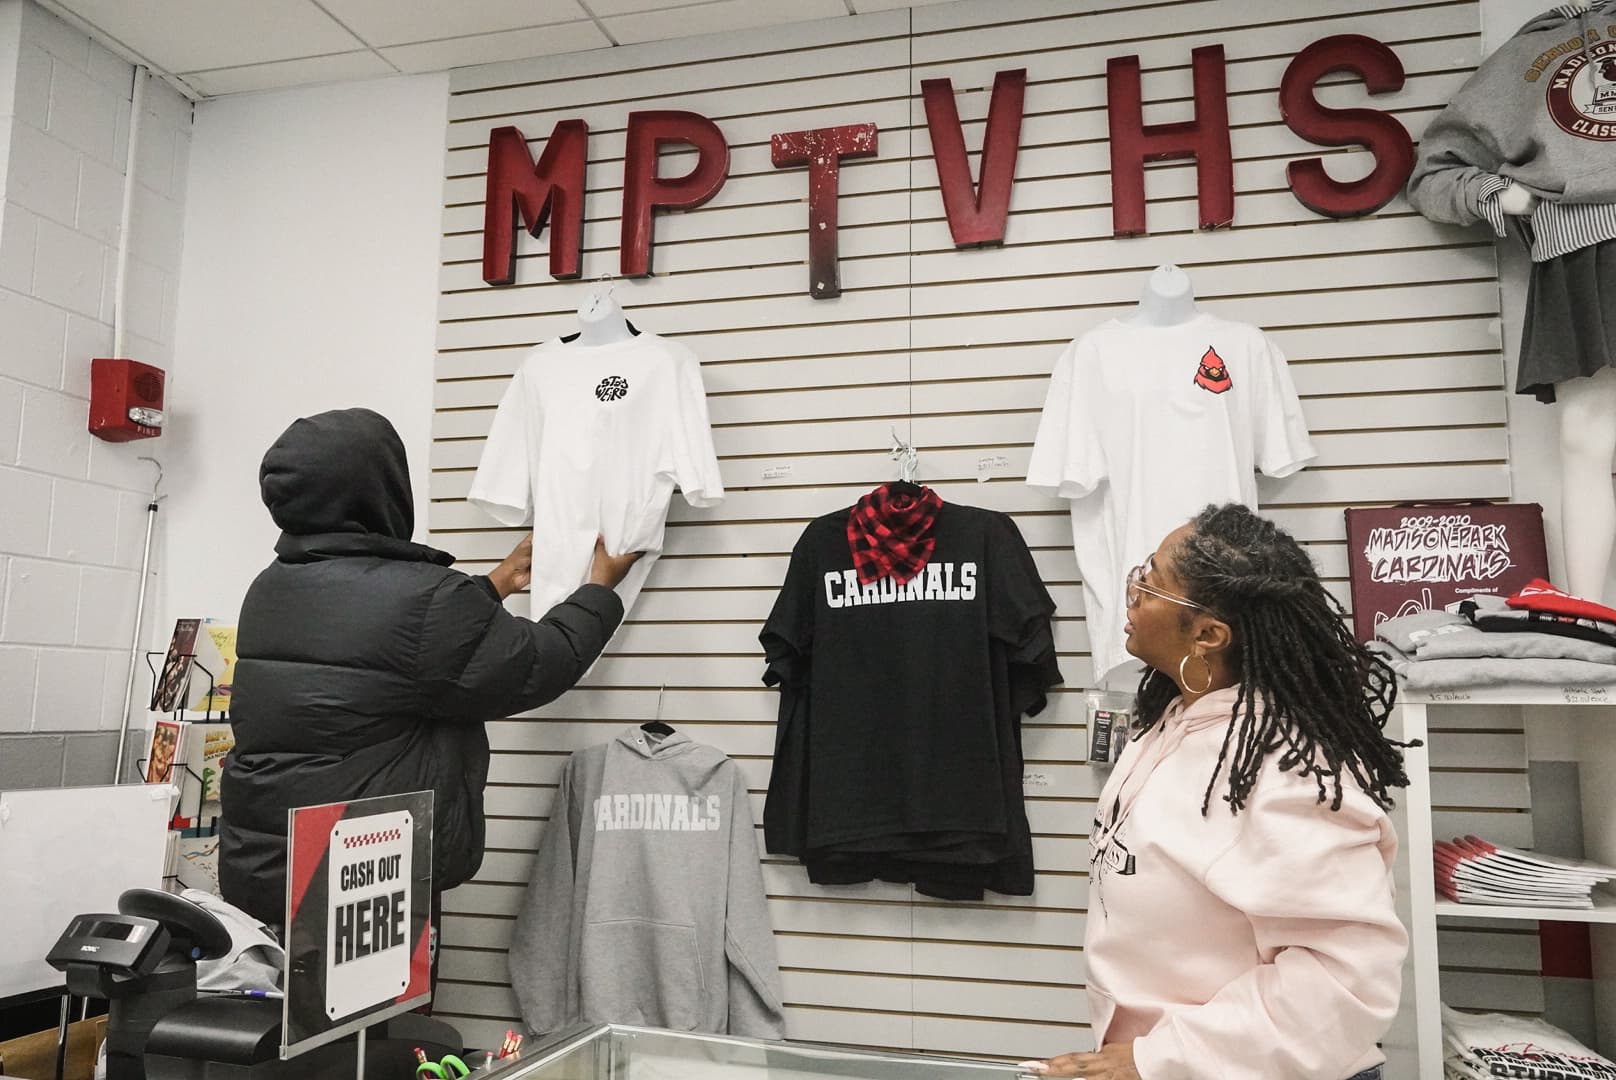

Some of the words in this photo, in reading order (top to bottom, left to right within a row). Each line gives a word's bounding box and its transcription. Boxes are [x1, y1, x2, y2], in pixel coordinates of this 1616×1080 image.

[1368, 526, 1451, 552] MADISON
[1458, 524, 1510, 552] PARK
[1400, 515, 1471, 528] 2009-2010
[1371, 550, 1511, 582] CARDINALS
[593, 793, 721, 832] ARDINALS
[341, 860, 375, 891] CASH
[378, 853, 401, 883] OUT
[334, 888, 406, 966] HERE
